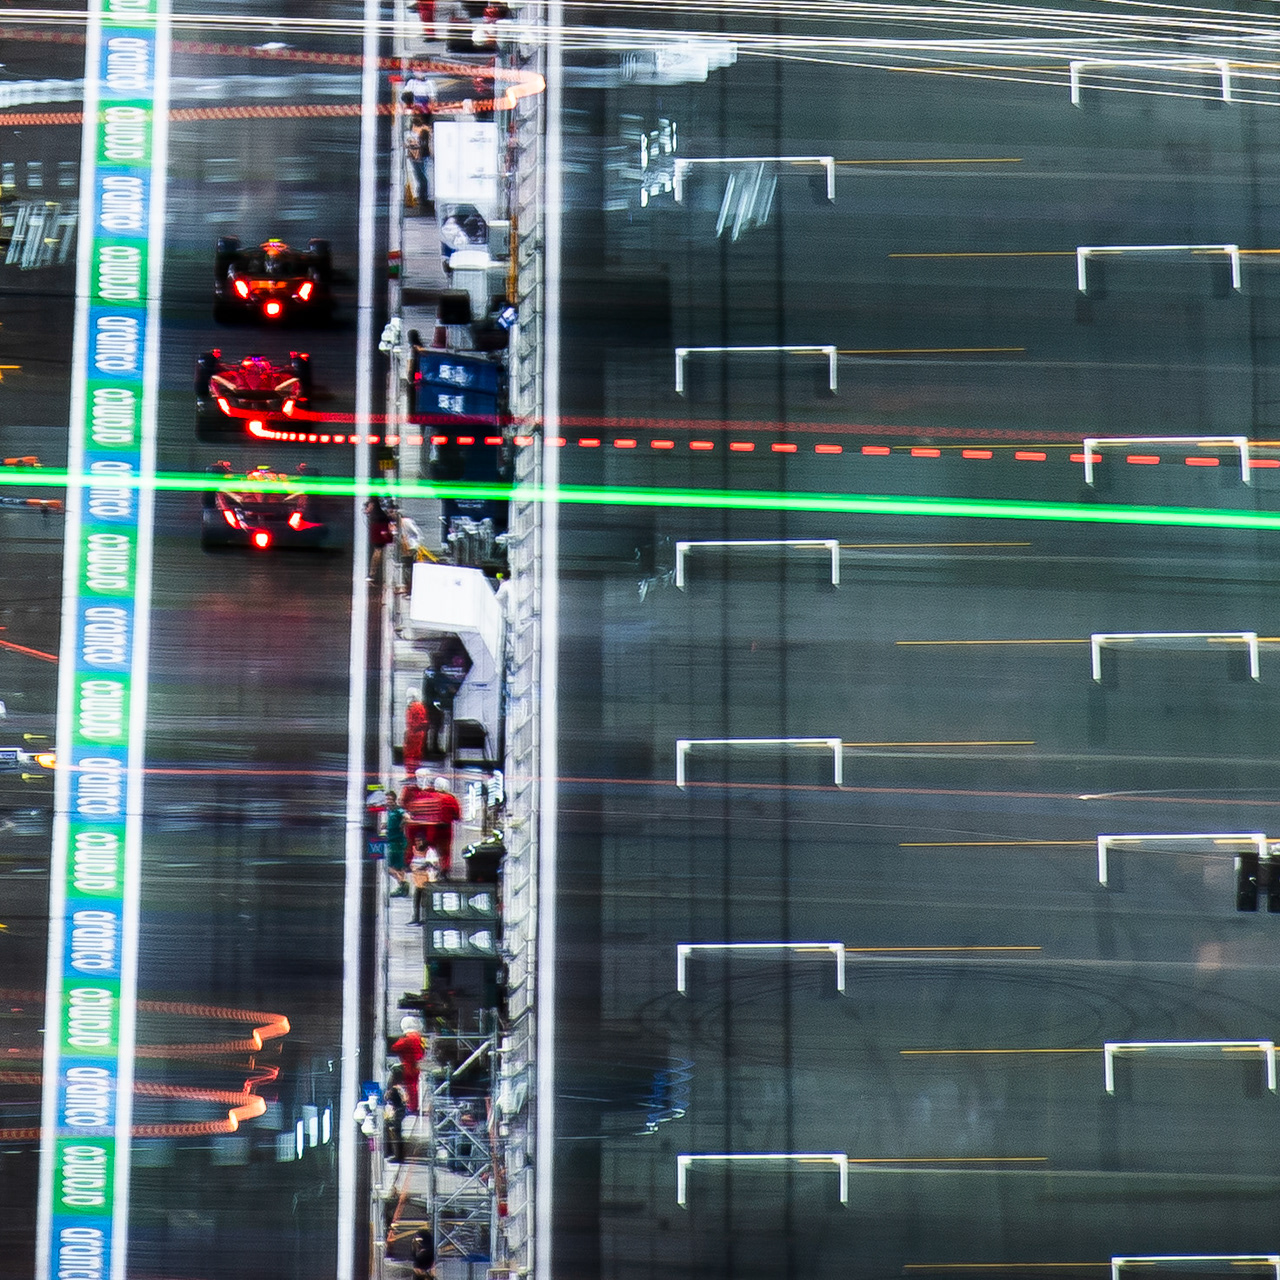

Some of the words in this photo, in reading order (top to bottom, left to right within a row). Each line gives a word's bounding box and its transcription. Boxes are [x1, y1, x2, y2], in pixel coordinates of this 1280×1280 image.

[105, 37, 148, 90] aramco
[103, 106, 145, 163] aramco
[100, 176, 144, 232] aramco
[98, 246, 140, 302] aramco
[94, 316, 137, 373] aramco
[92, 388, 136, 447] aramco
[90, 461, 133, 519] aramco
[86, 532, 130, 592] aramco
[82, 607, 127, 665] aramco
[79, 680, 124, 740] aramco
[77, 756, 122, 815] aramco
[74, 831, 120, 892] aramco
[71, 910, 116, 972] aramco
[68, 987, 113, 1050] aramco
[64, 1066, 110, 1129] aramco
[61, 1145, 106, 1207] aramco
[58, 1226, 103, 1280] aramc
